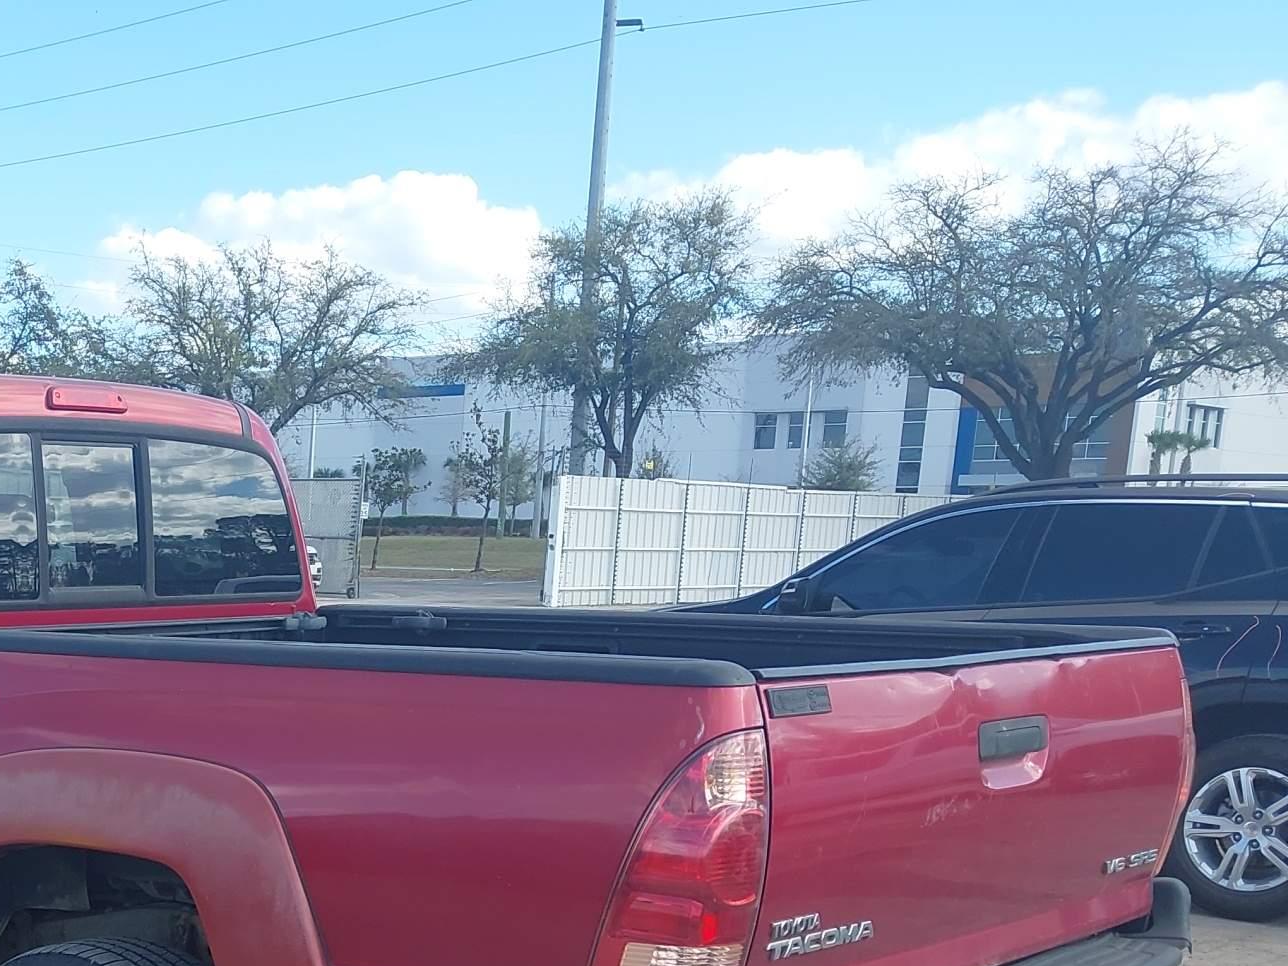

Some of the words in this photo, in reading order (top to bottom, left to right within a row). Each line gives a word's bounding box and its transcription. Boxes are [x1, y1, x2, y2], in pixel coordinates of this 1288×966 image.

[1105, 857, 1126, 874] V6
[772, 912, 821, 938] TOYOTA
[766, 920, 873, 960] TACOMA
